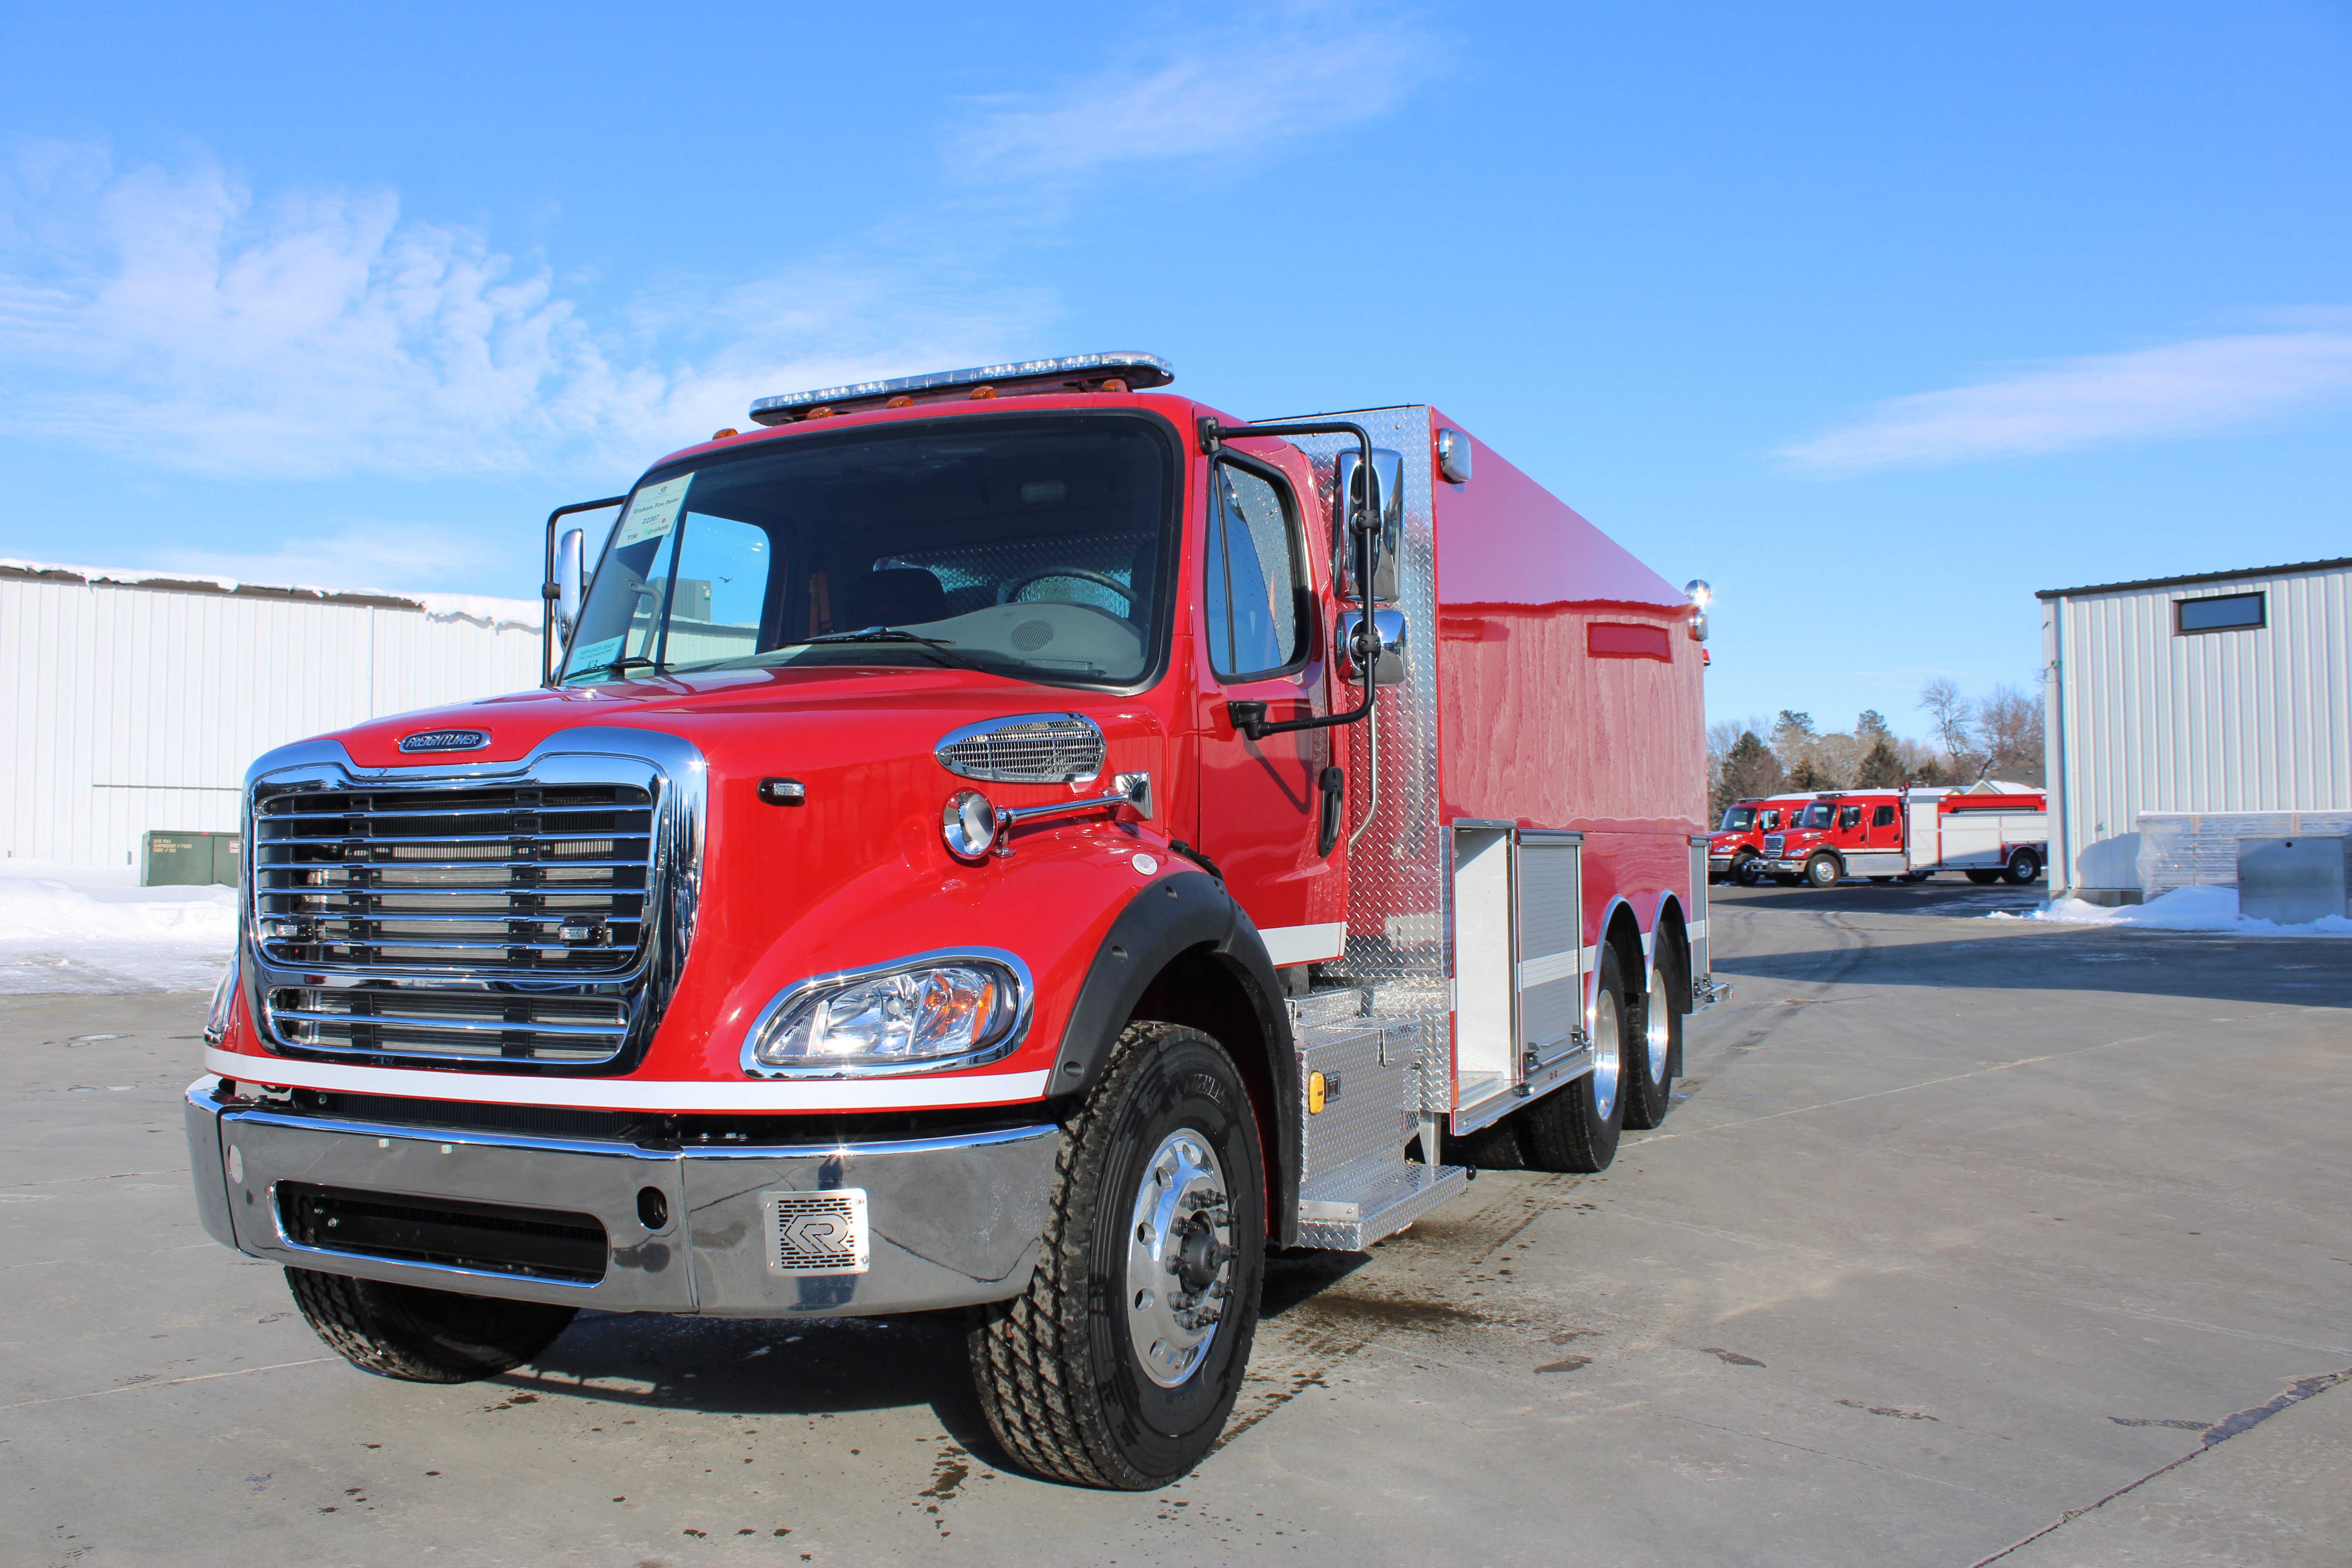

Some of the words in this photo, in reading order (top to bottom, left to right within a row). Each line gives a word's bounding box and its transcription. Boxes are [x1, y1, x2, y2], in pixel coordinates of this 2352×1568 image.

[633, 505, 653, 514] Graham
[642, 514, 660, 524] 22207
[647, 524, 669, 535] Graham
[406, 734, 479, 748] FREIGHTLINER
[1183, 1073, 1233, 1113] MICHELIN
